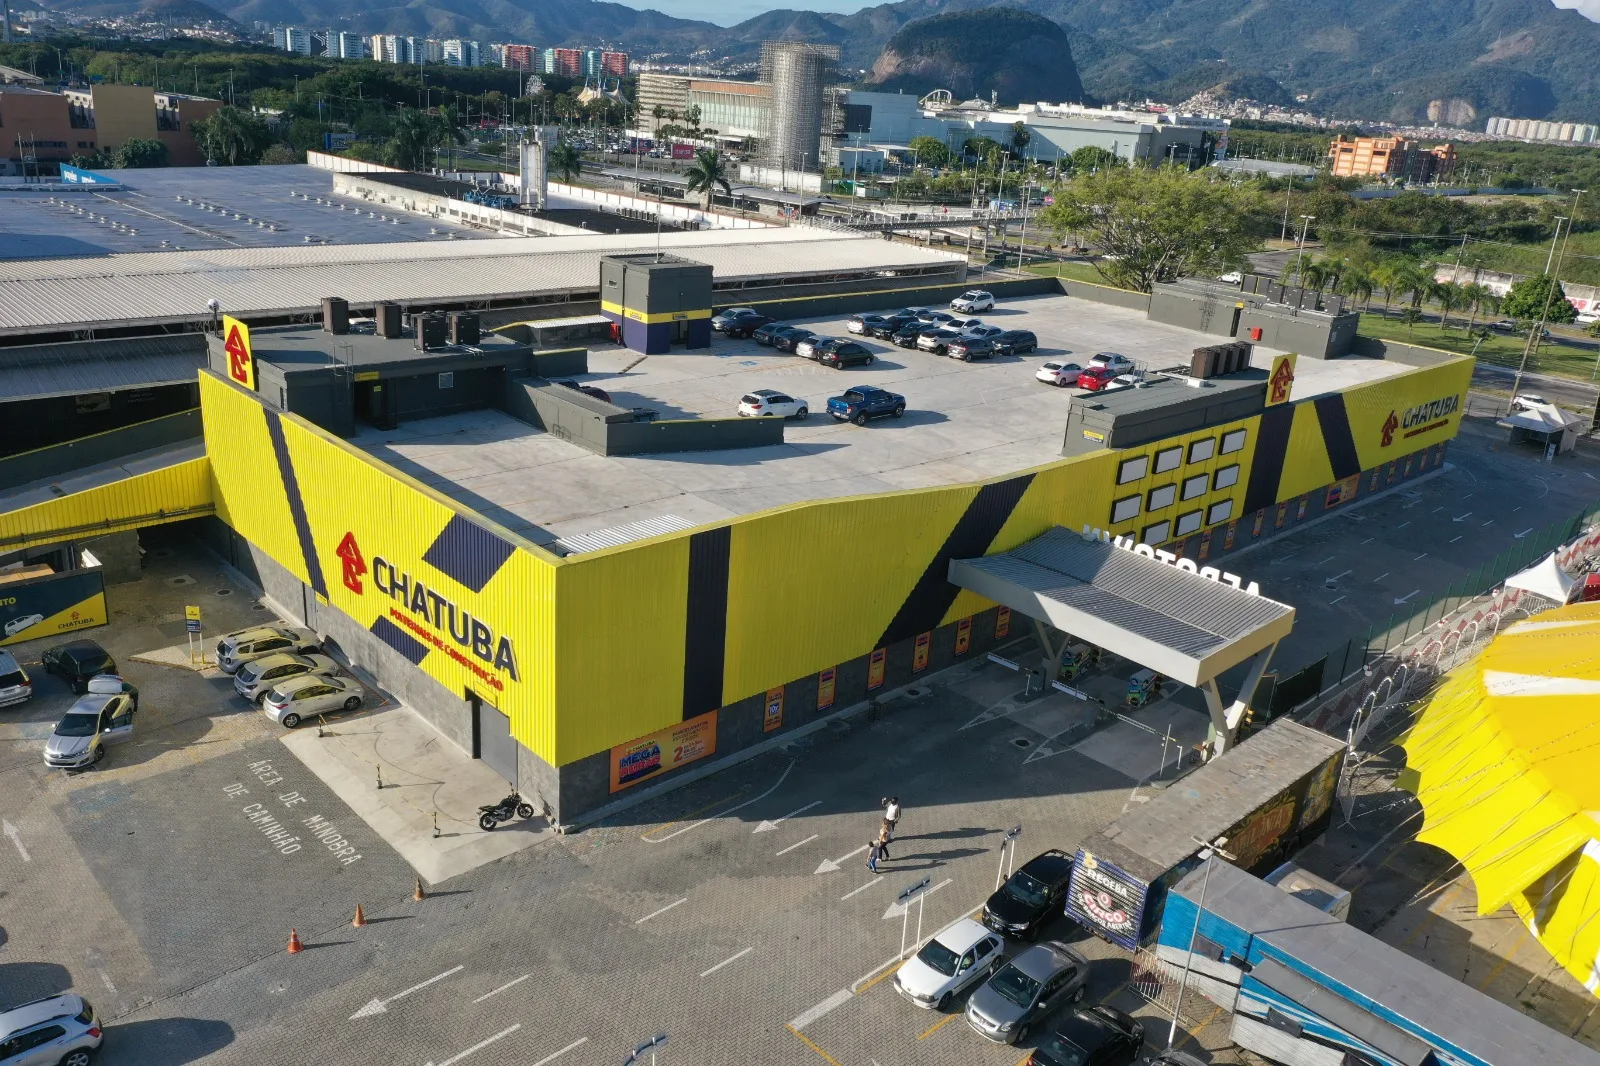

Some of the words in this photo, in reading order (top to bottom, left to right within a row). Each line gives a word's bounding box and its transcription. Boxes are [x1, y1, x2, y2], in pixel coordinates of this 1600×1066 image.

[1402, 394, 1459, 429] CHATUBA
[58, 617, 94, 630] CHATUBA
[372, 556, 521, 683] CHATUBA
[673, 746, 683, 762] 2
[222, 783, 250, 799] DE
[243, 803, 302, 855] CAMINHÃO
[247, 759, 283, 787] ÁREA
[279, 791, 307, 808] DE
[302, 814, 362, 866] MANOBRA
[1086, 869, 1128, 898] RECEBA
[1083, 891, 1126, 923] CIRCO
